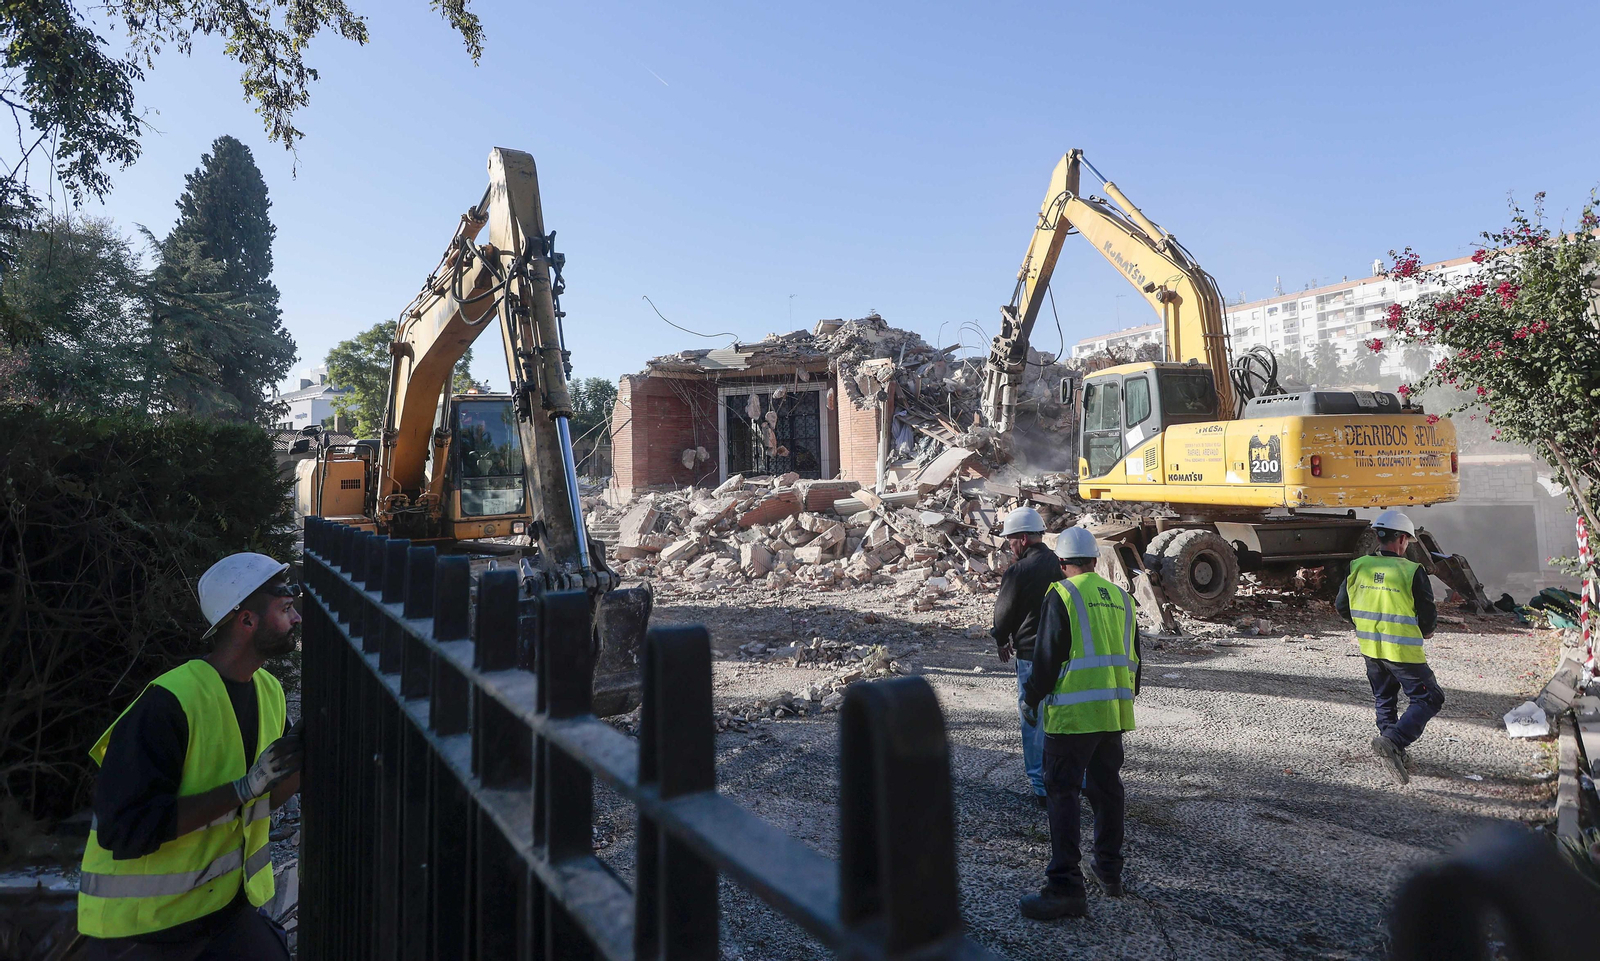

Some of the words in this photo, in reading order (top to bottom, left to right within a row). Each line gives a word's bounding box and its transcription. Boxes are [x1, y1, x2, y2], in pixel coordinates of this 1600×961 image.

[1344, 424, 1408, 446] DERRIBOS
[1250, 445, 1270, 461] PW
[1252, 460, 1279, 473] 200
[1168, 472, 1203, 482] KOMATSU
